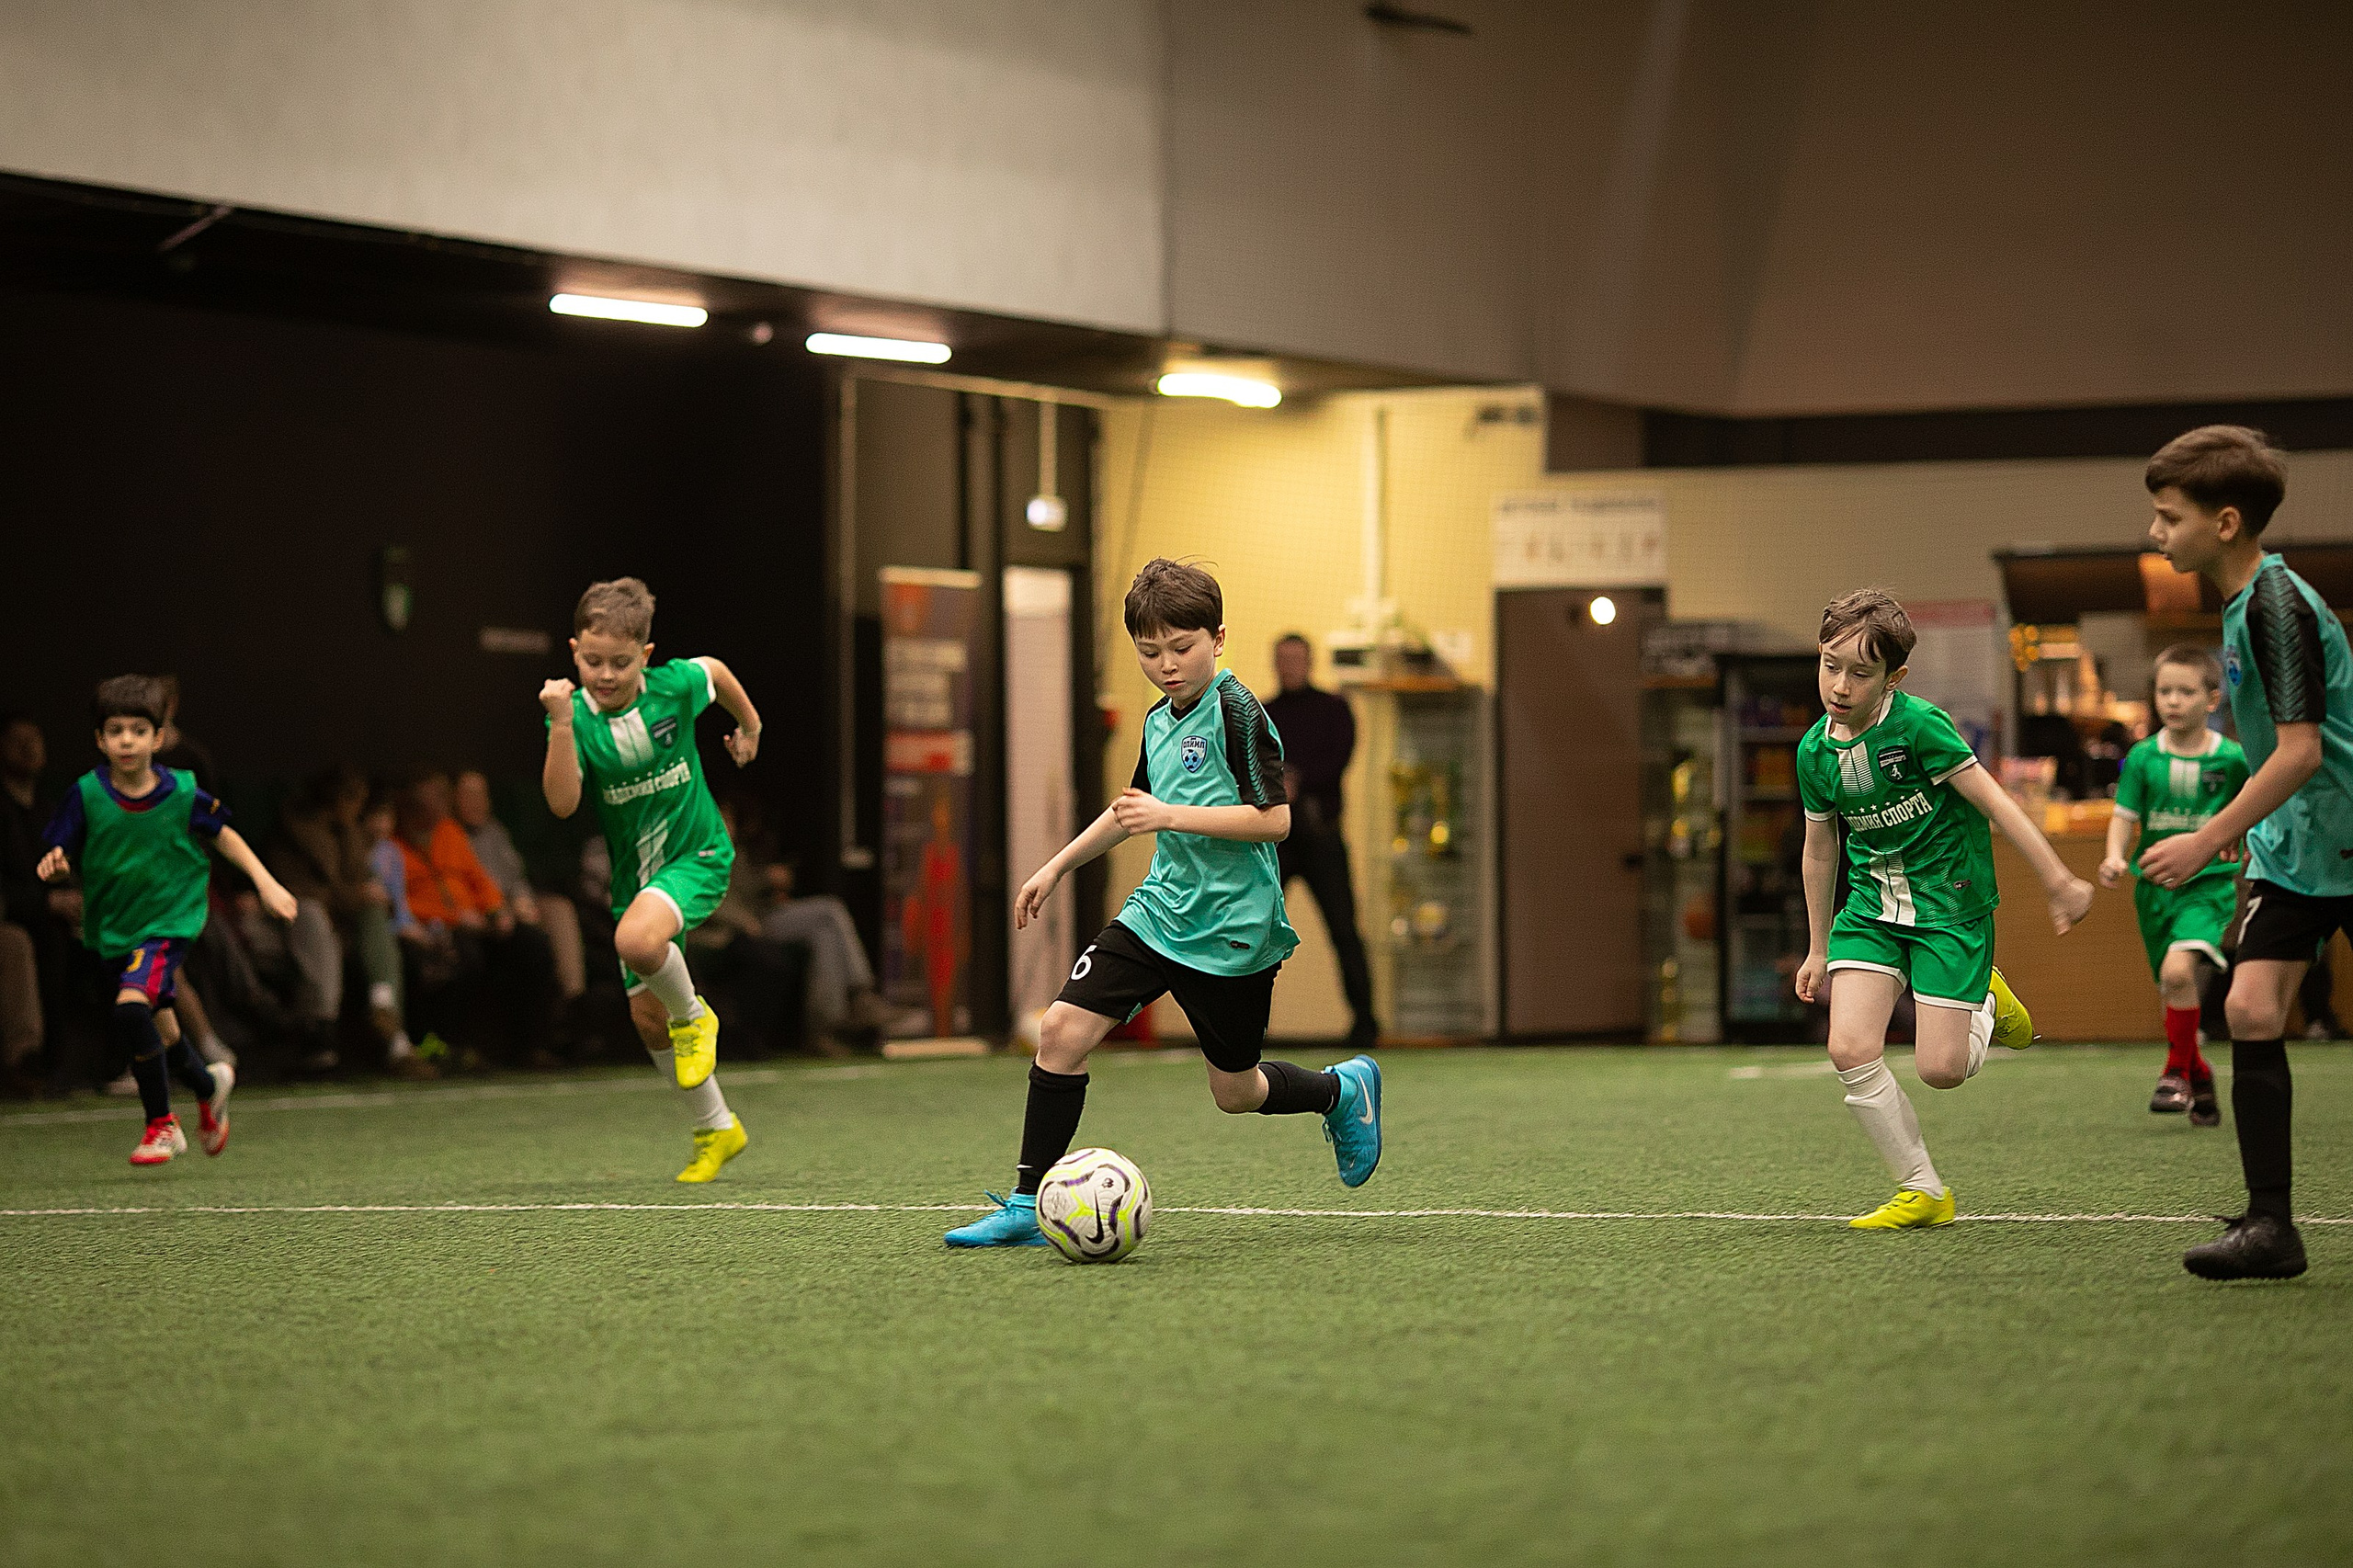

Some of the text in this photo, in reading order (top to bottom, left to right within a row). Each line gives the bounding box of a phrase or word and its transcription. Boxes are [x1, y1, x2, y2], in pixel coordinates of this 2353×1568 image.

[1881, 791, 1933, 827] СПОРТА
[2237, 895, 2263, 945] 7
[1070, 944, 1097, 981] 6
